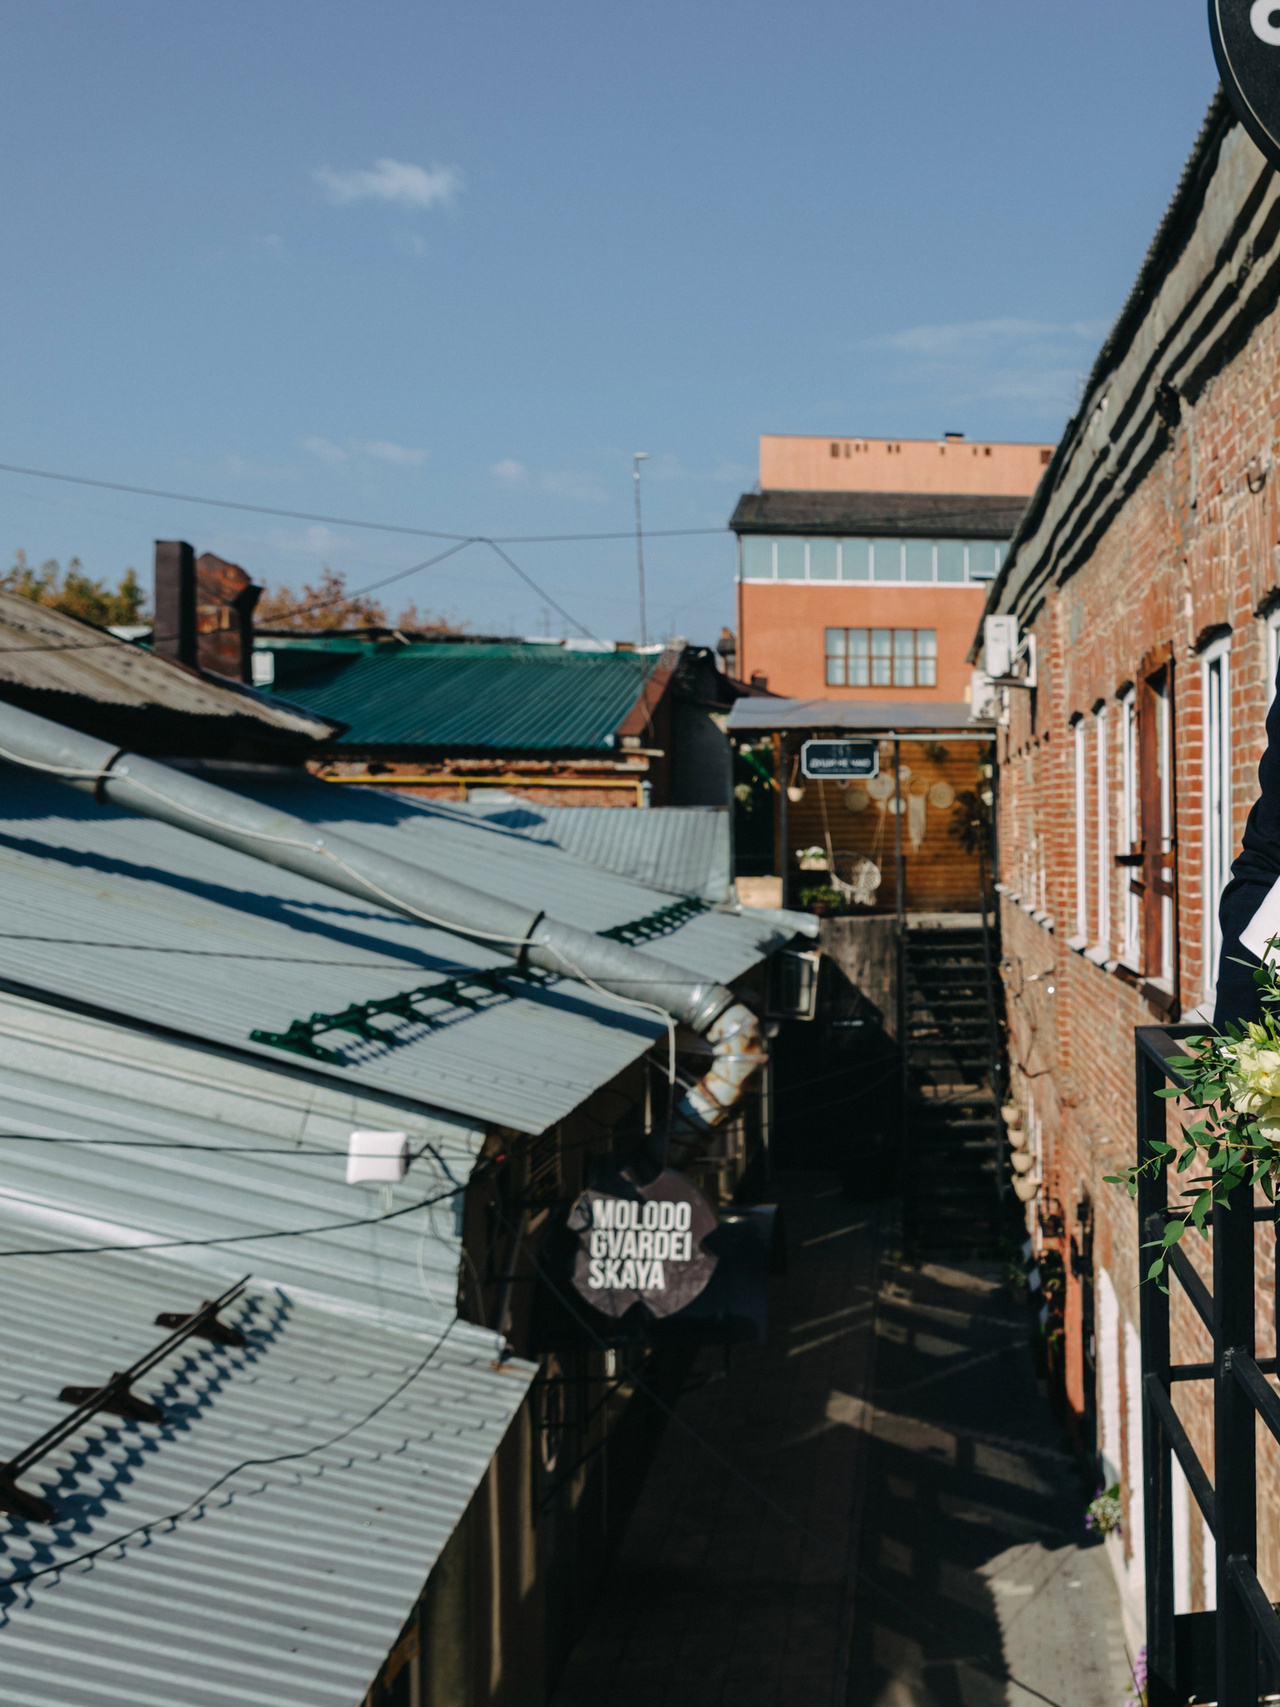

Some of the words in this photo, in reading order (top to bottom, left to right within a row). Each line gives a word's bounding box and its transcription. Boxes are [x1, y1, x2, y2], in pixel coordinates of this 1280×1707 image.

[592, 1199, 692, 1232] MOLODO
[590, 1230, 693, 1262] GVARDEI
[587, 1258, 666, 1290] SKAYA
